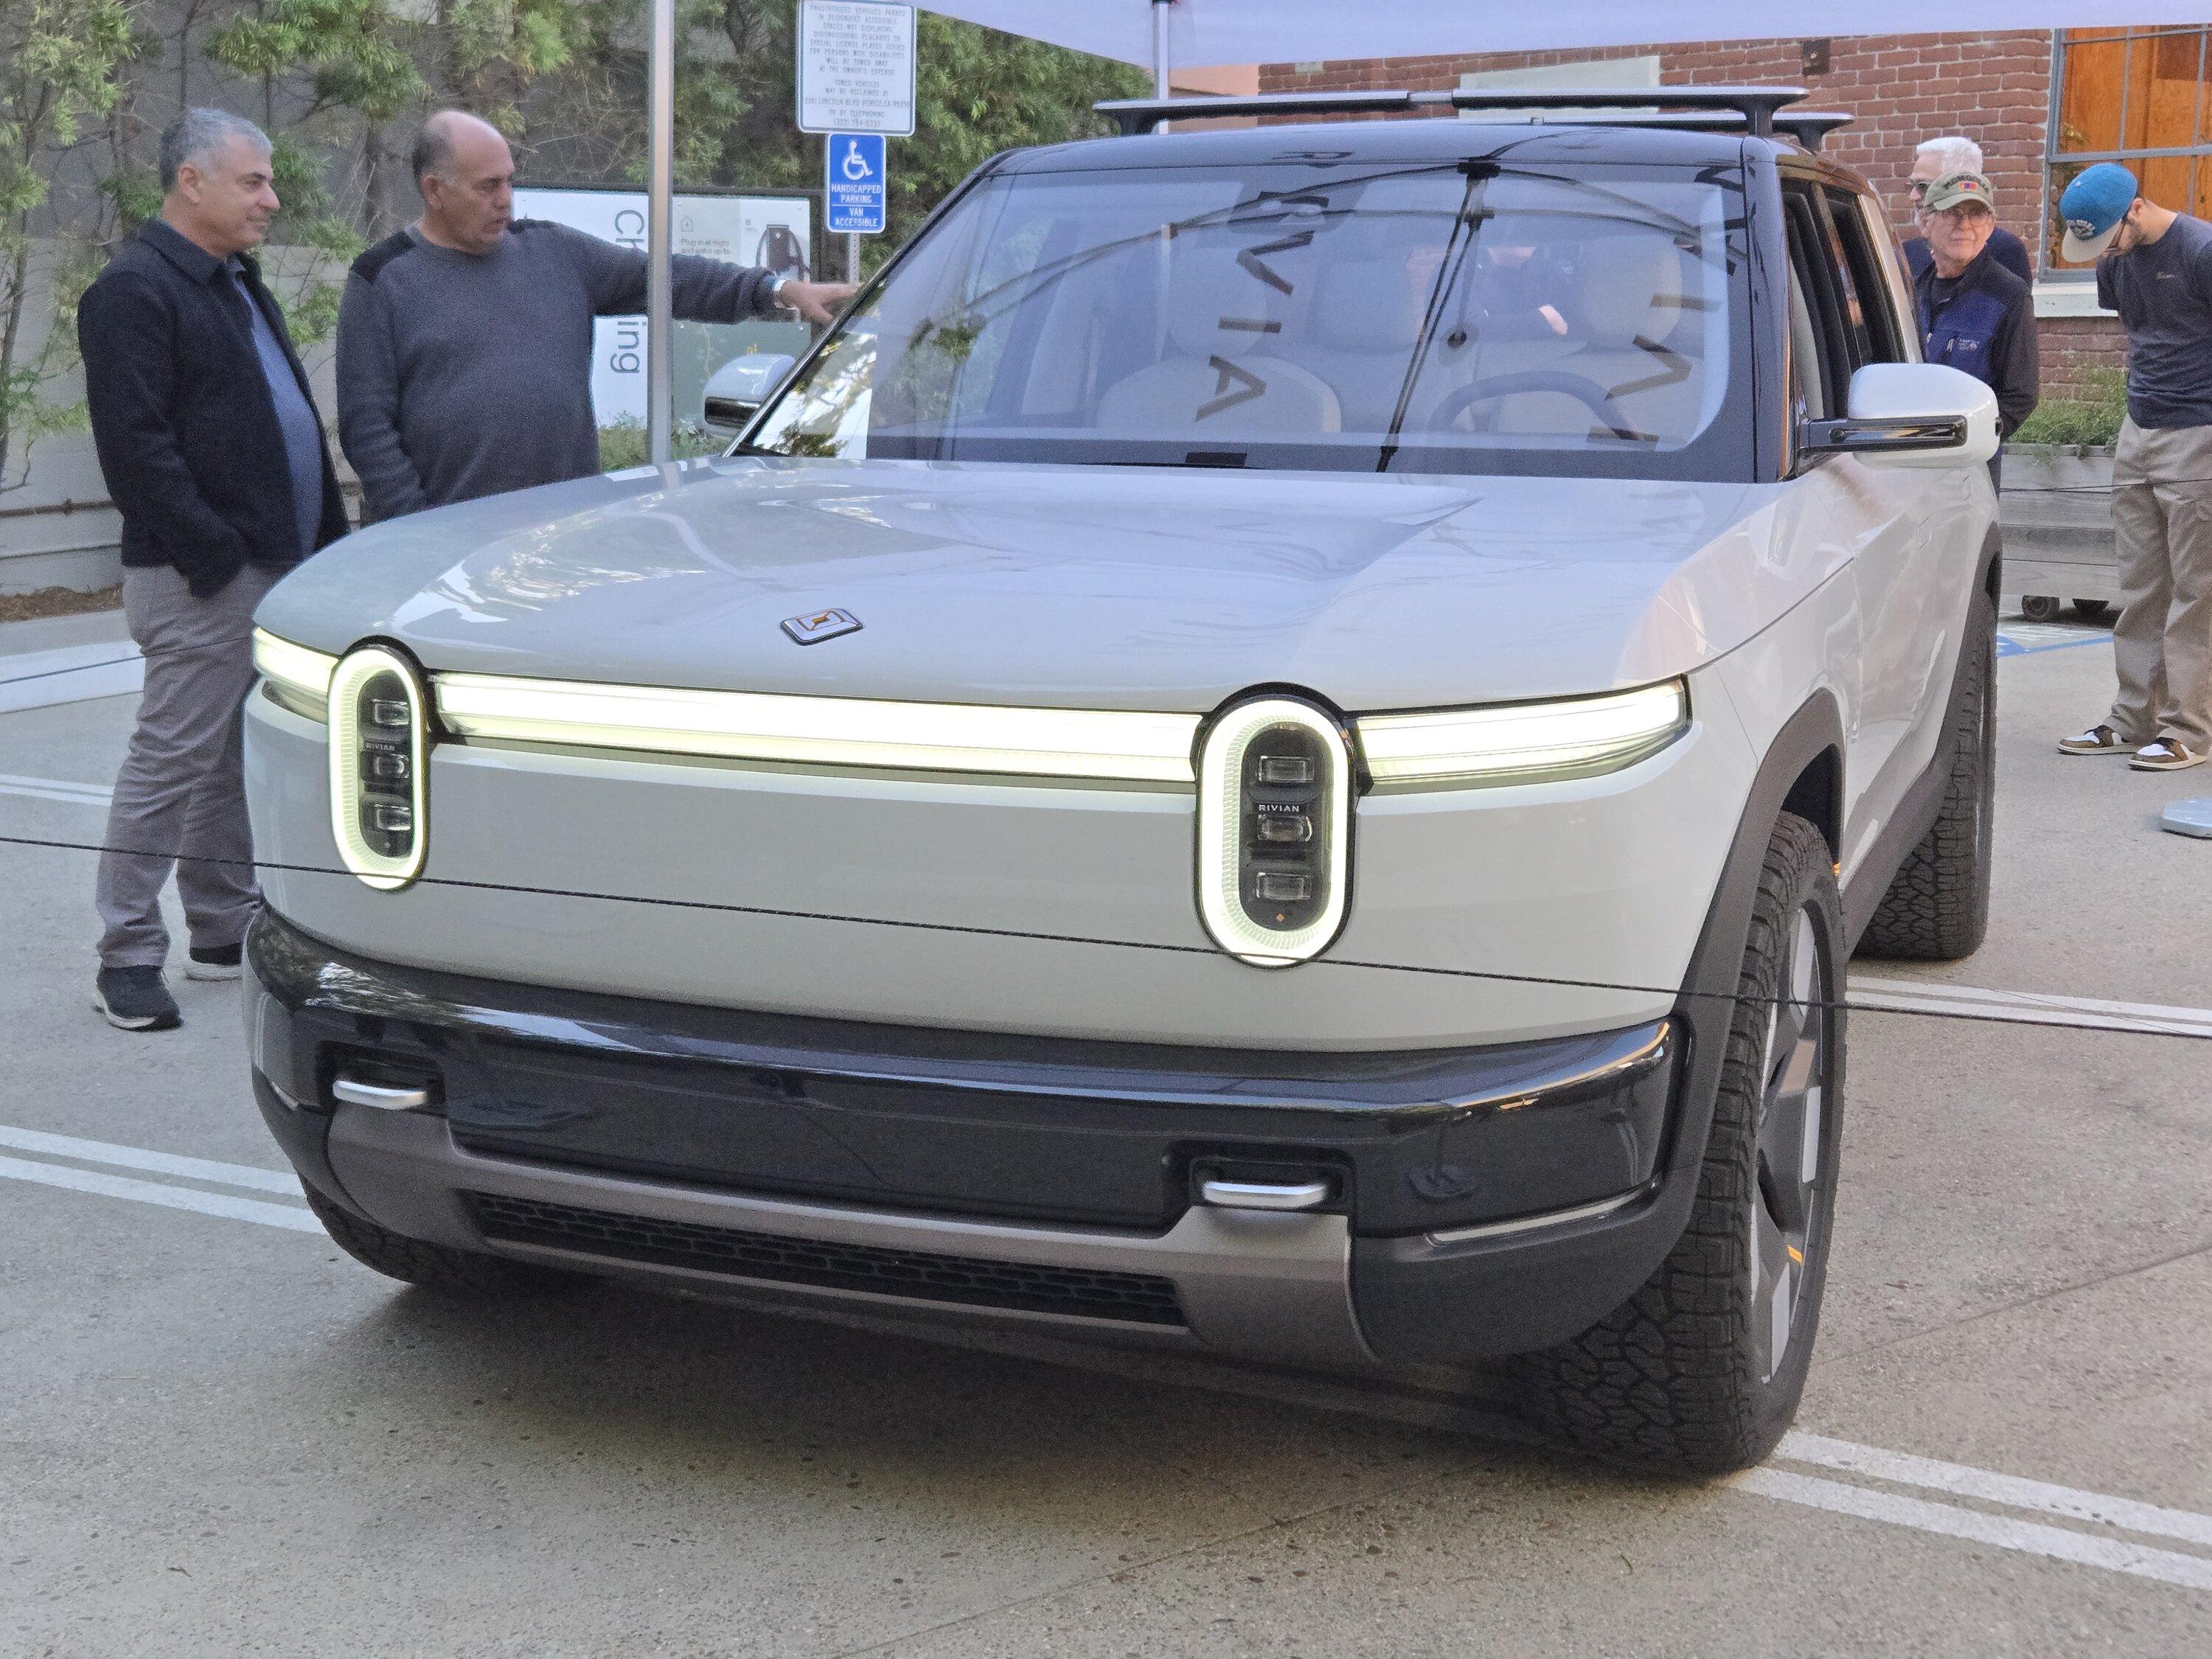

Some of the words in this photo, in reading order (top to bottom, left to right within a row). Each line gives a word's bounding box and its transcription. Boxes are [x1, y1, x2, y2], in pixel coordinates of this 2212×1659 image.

[832, 184, 881, 193] HANDICAPPED
[841, 195, 872, 204] PARKING
[849, 207, 863, 216] VAN
[835, 217, 878, 227] ACCESSIBLE
[610, 209, 647, 374] Ching
